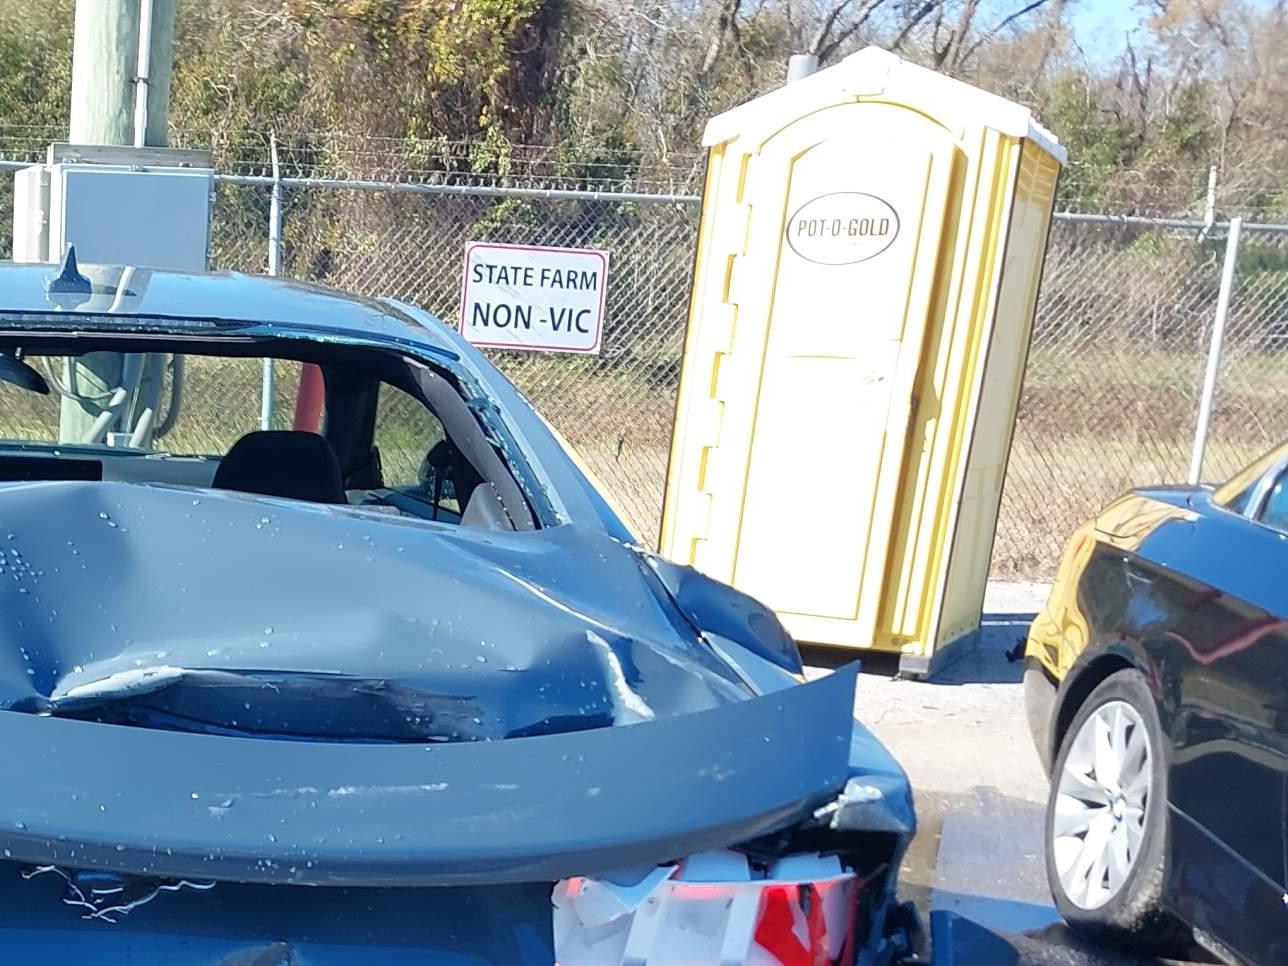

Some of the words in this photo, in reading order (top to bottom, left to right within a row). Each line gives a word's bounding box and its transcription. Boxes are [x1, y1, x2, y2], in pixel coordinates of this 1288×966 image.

[797, 218, 890, 237] POT-O-GOLD
[472, 263, 535, 286] STATE
[540, 268, 598, 291] FARM
[472, 302, 532, 329] NON
